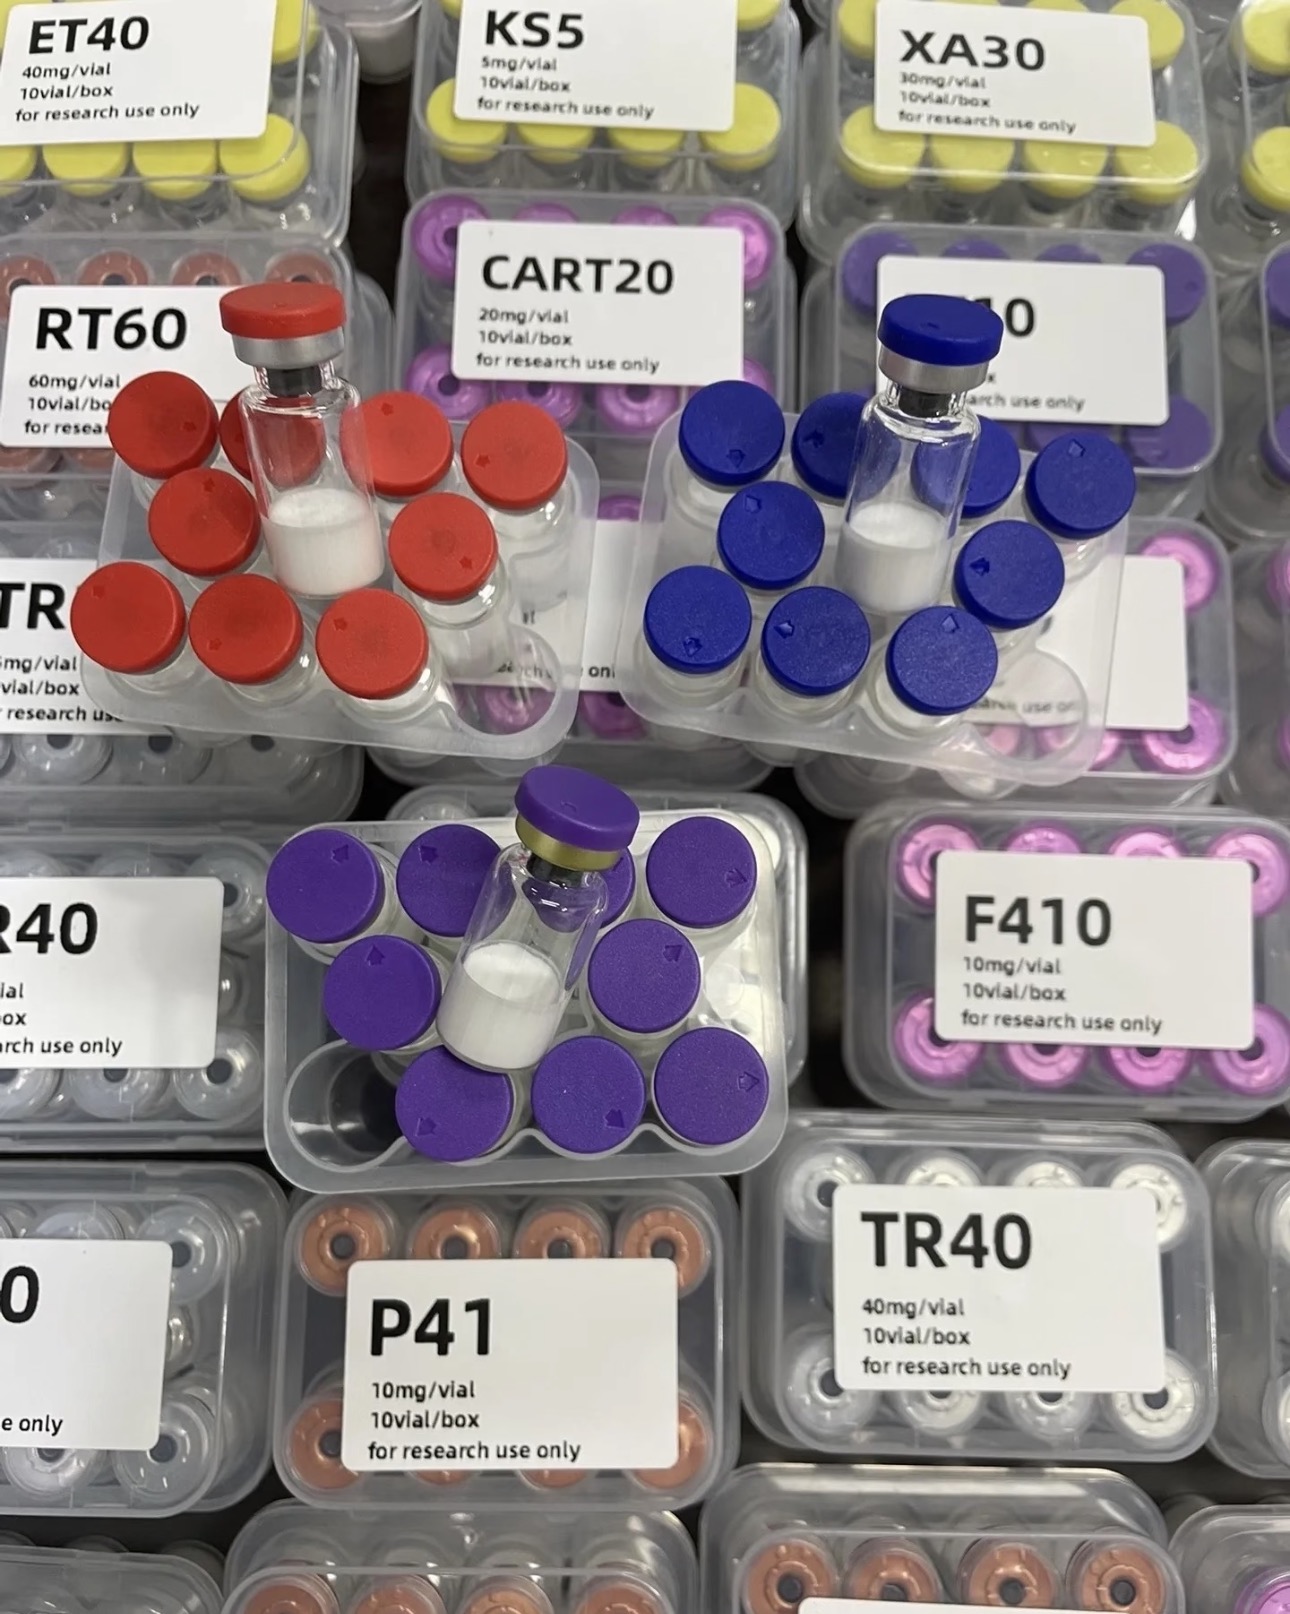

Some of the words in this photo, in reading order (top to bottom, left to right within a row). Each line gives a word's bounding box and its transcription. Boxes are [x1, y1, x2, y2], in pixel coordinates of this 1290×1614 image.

[28, 15, 150, 55] ET40
[485, 9, 584, 50] KS5
[900, 29, 1045, 72] XA30
[21, 62, 111, 81] 40mg/vial
[481, 55, 557, 73] 5mg/vial
[481, 75, 571, 93] 10vial/box
[900, 71, 986, 90] 30mg/vial
[20, 84, 113, 101] 10vial/box
[900, 90, 991, 108] 10vial/box
[15, 108, 40, 122] for
[45, 104, 119, 121] research
[124, 106, 155, 118] use
[159, 102, 200, 119] only
[477, 95, 501, 110] for
[505, 100, 579, 114] research
[582, 105, 613, 116] use
[616, 104, 655, 121] only
[898, 109, 922, 123] for
[926, 113, 1001, 128] research
[1004, 119, 1035, 131] use
[1037, 119, 1077, 136] only
[482, 254, 674, 296] CART20
[478, 307, 569, 326] 20mg/vial
[35, 307, 188, 351] RT60
[479, 329, 572, 346] 10vial/box
[476, 352, 501, 367] for
[505, 355, 581, 369] research
[586, 359, 617, 371] use
[620, 357, 660, 376] only
[28, 374, 120, 392] 60mg/vial
[28, 396, 112, 412] 10vial/bo
[1010, 397, 1042, 409] use
[1045, 396, 1086, 414] only
[24, 419, 49, 434] for
[54, 421, 108, 435] resea
[0, 581, 66, 631] TR
[0, 655, 77, 675] mg/vial
[7, 705, 88, 722] research
[0, 901, 98, 956] 40
[965, 894, 1112, 947] F410
[963, 955, 1061, 978] 10mg/vial
[963, 982, 1067, 1002] 10vial/box
[960, 1008, 989, 1027] for
[993, 1013, 1077, 1030] research
[1081, 1017, 1115, 1031] use
[1119, 1016, 1163, 1037] only
[40, 1040, 74, 1054] use
[79, 1036, 123, 1058] only
[860, 1211, 1032, 1270] TR40
[862, 1297, 965, 1321] 40mg/vial
[370, 1298, 491, 1357] P41
[863, 1326, 971, 1346] 10vial/box
[861, 1355, 891, 1375] for
[896, 1358, 982, 1376] research
[987, 1362, 1022, 1377] use
[1027, 1358, 1071, 1381] only
[372, 1380, 475, 1404] 10mg/vial
[18, 1414, 64, 1437] only
[371, 1409, 480, 1429] 10vial/box
[367, 1441, 398, 1460] for
[402, 1440, 490, 1460] research
[496, 1444, 531, 1459] use
[536, 1440, 581, 1463] only
